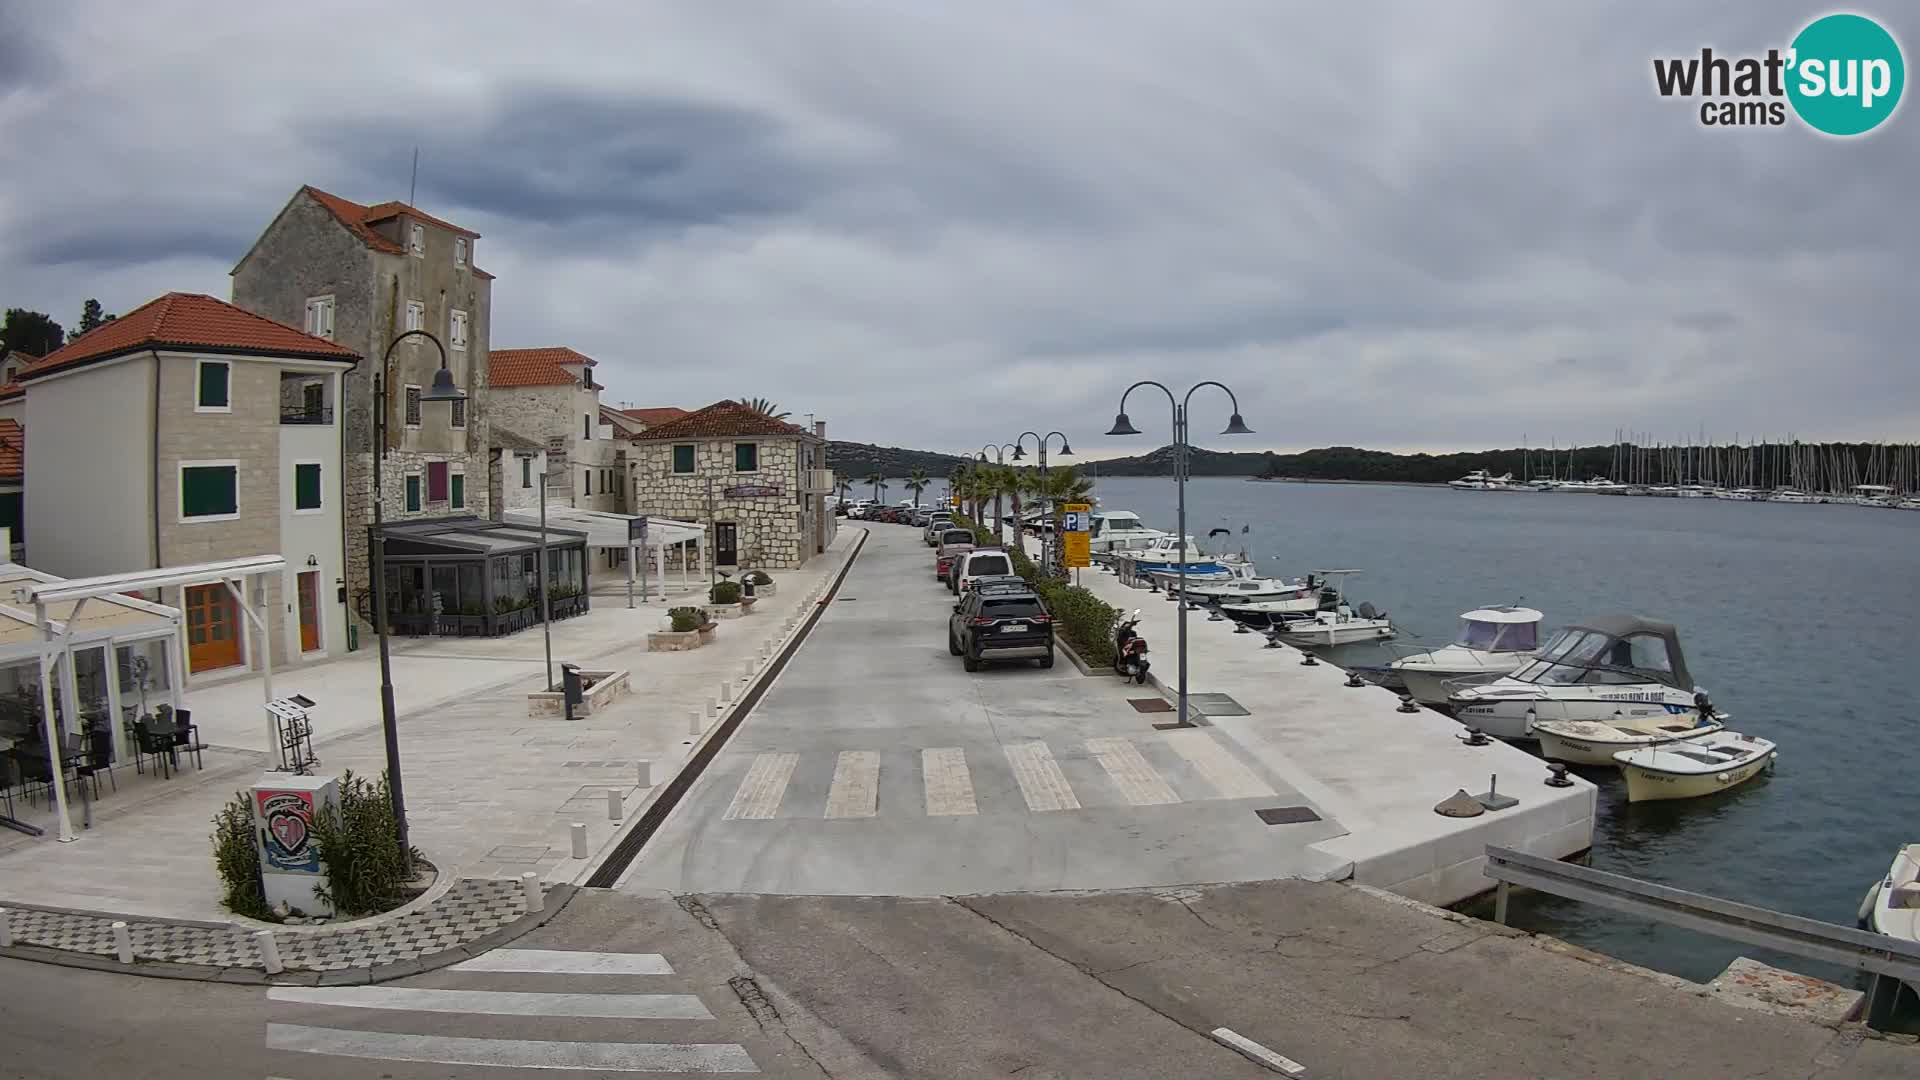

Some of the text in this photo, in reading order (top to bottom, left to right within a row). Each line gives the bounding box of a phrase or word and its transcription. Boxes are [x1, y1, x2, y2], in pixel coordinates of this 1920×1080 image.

[1066, 514, 1077, 530] P
[1629, 692, 1644, 701] RENT
[1650, 692, 1665, 702] BOAT
